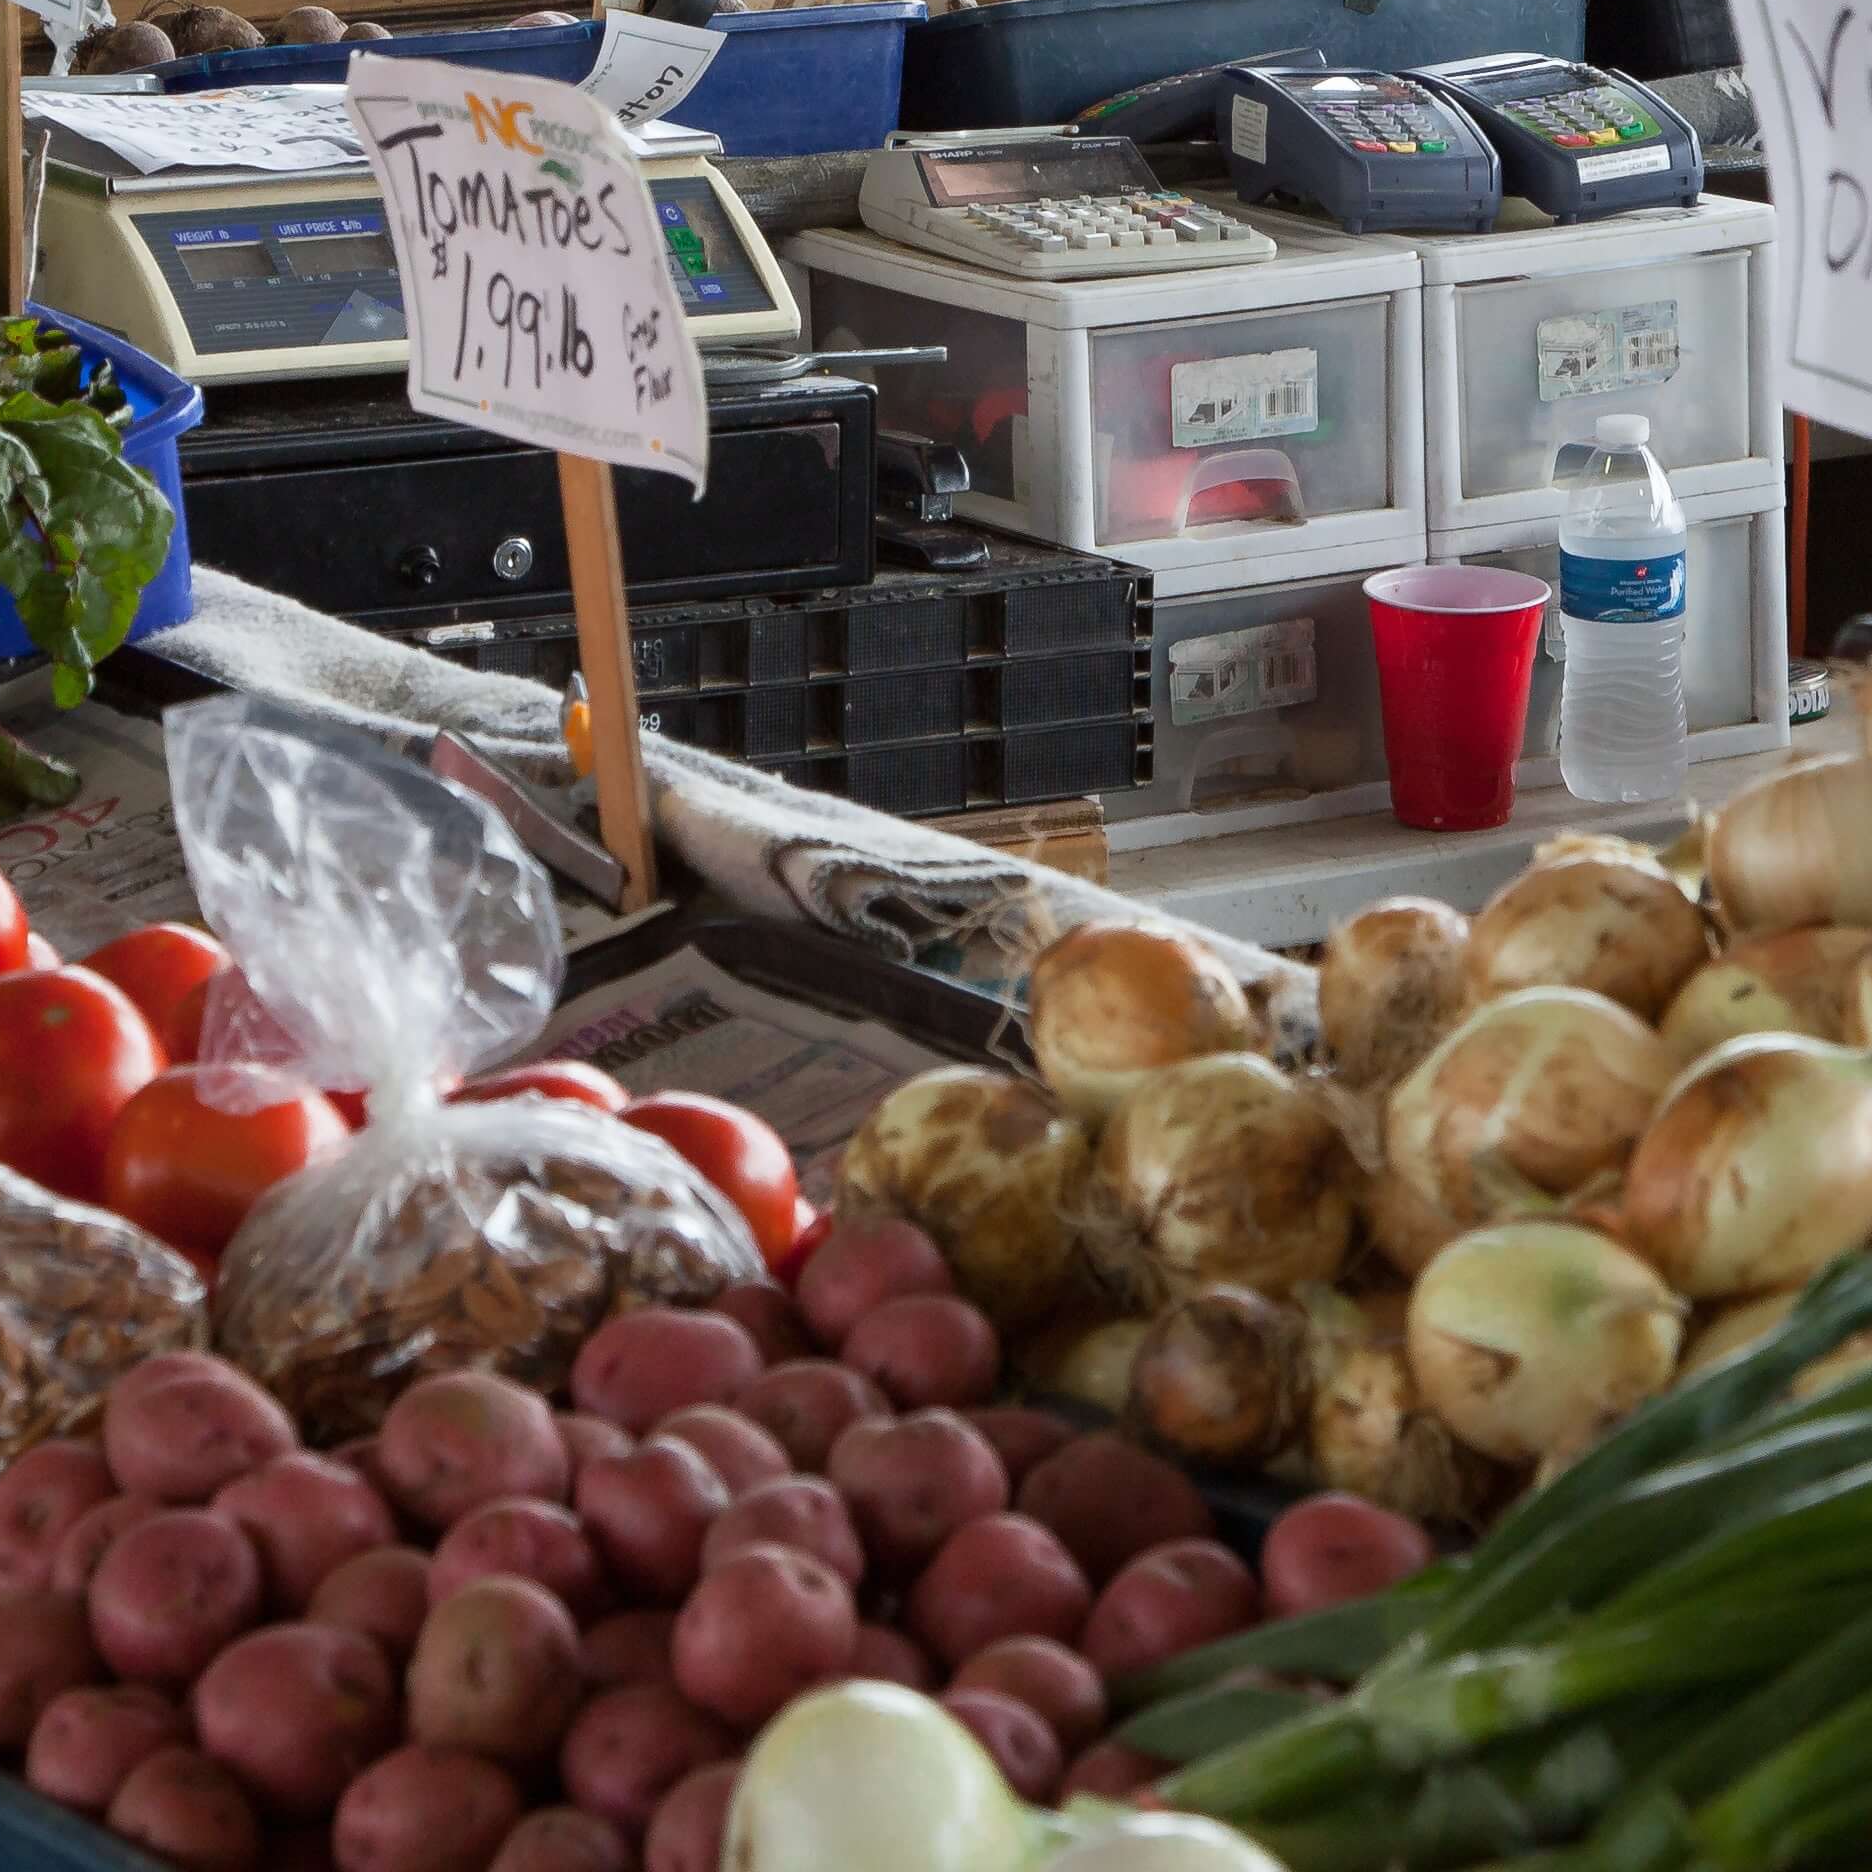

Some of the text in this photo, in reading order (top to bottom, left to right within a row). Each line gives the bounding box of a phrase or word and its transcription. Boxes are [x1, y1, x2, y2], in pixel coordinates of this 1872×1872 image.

[464, 89, 544, 157] NC
[927, 149, 974, 160] SHARP
[175, 219, 363, 243] WEIGHT lb UNIT PRICE $/lb
[1610, 586, 1644, 597] Purified
